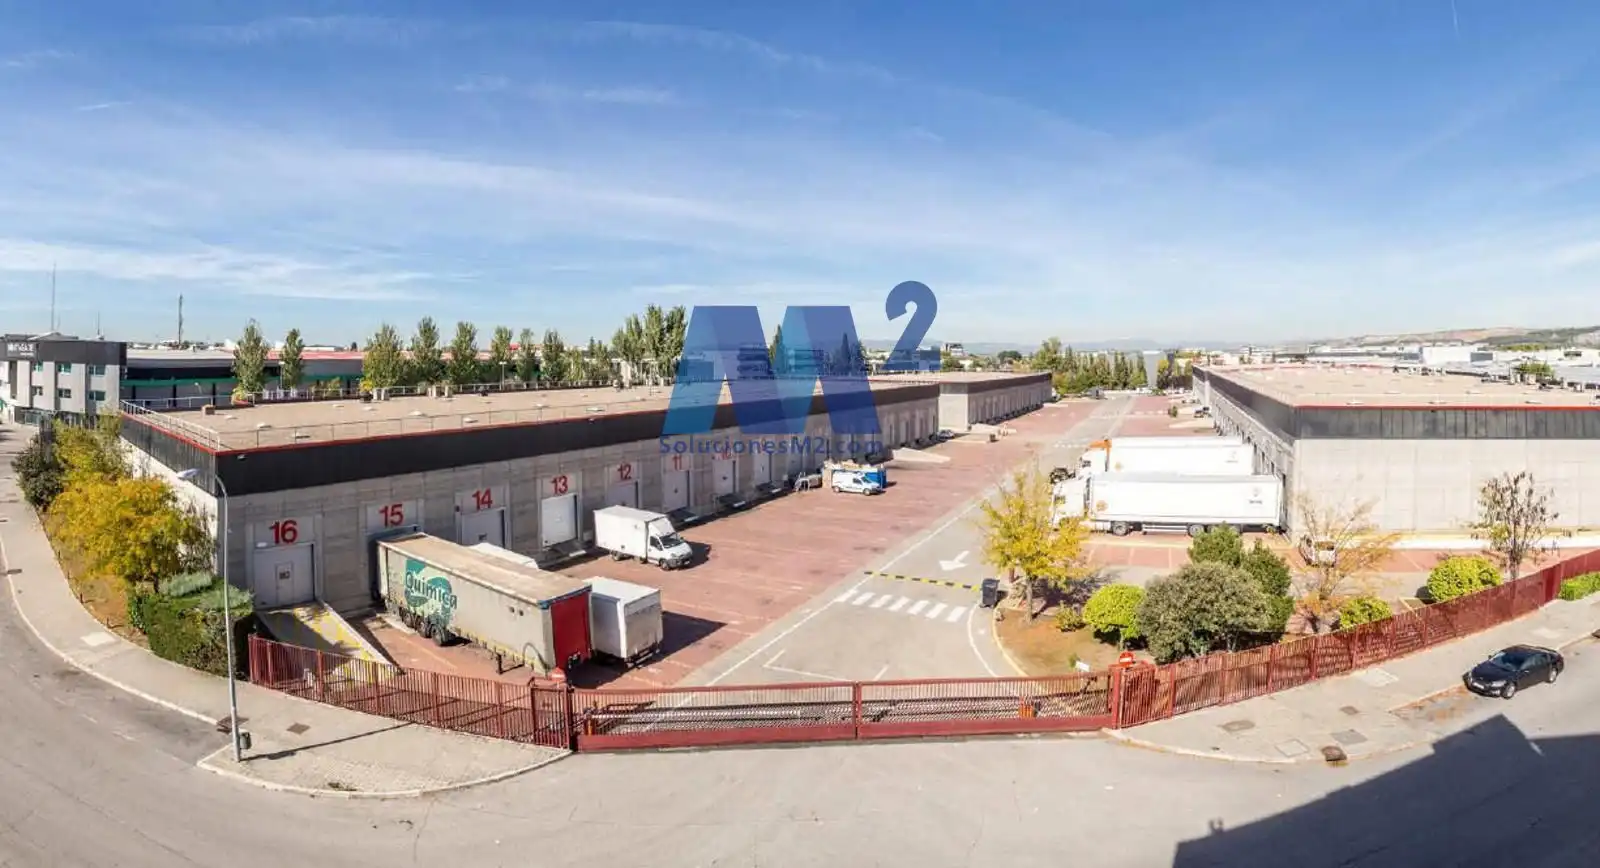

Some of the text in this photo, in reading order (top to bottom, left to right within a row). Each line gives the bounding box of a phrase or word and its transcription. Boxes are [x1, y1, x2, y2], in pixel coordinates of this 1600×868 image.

[617, 463, 632, 480] 12
[672, 455, 683, 471] 11
[551, 475, 568, 494] 13
[472, 488, 493, 510] 14
[379, 504, 404, 526] 15
[269, 520, 298, 544] 16
